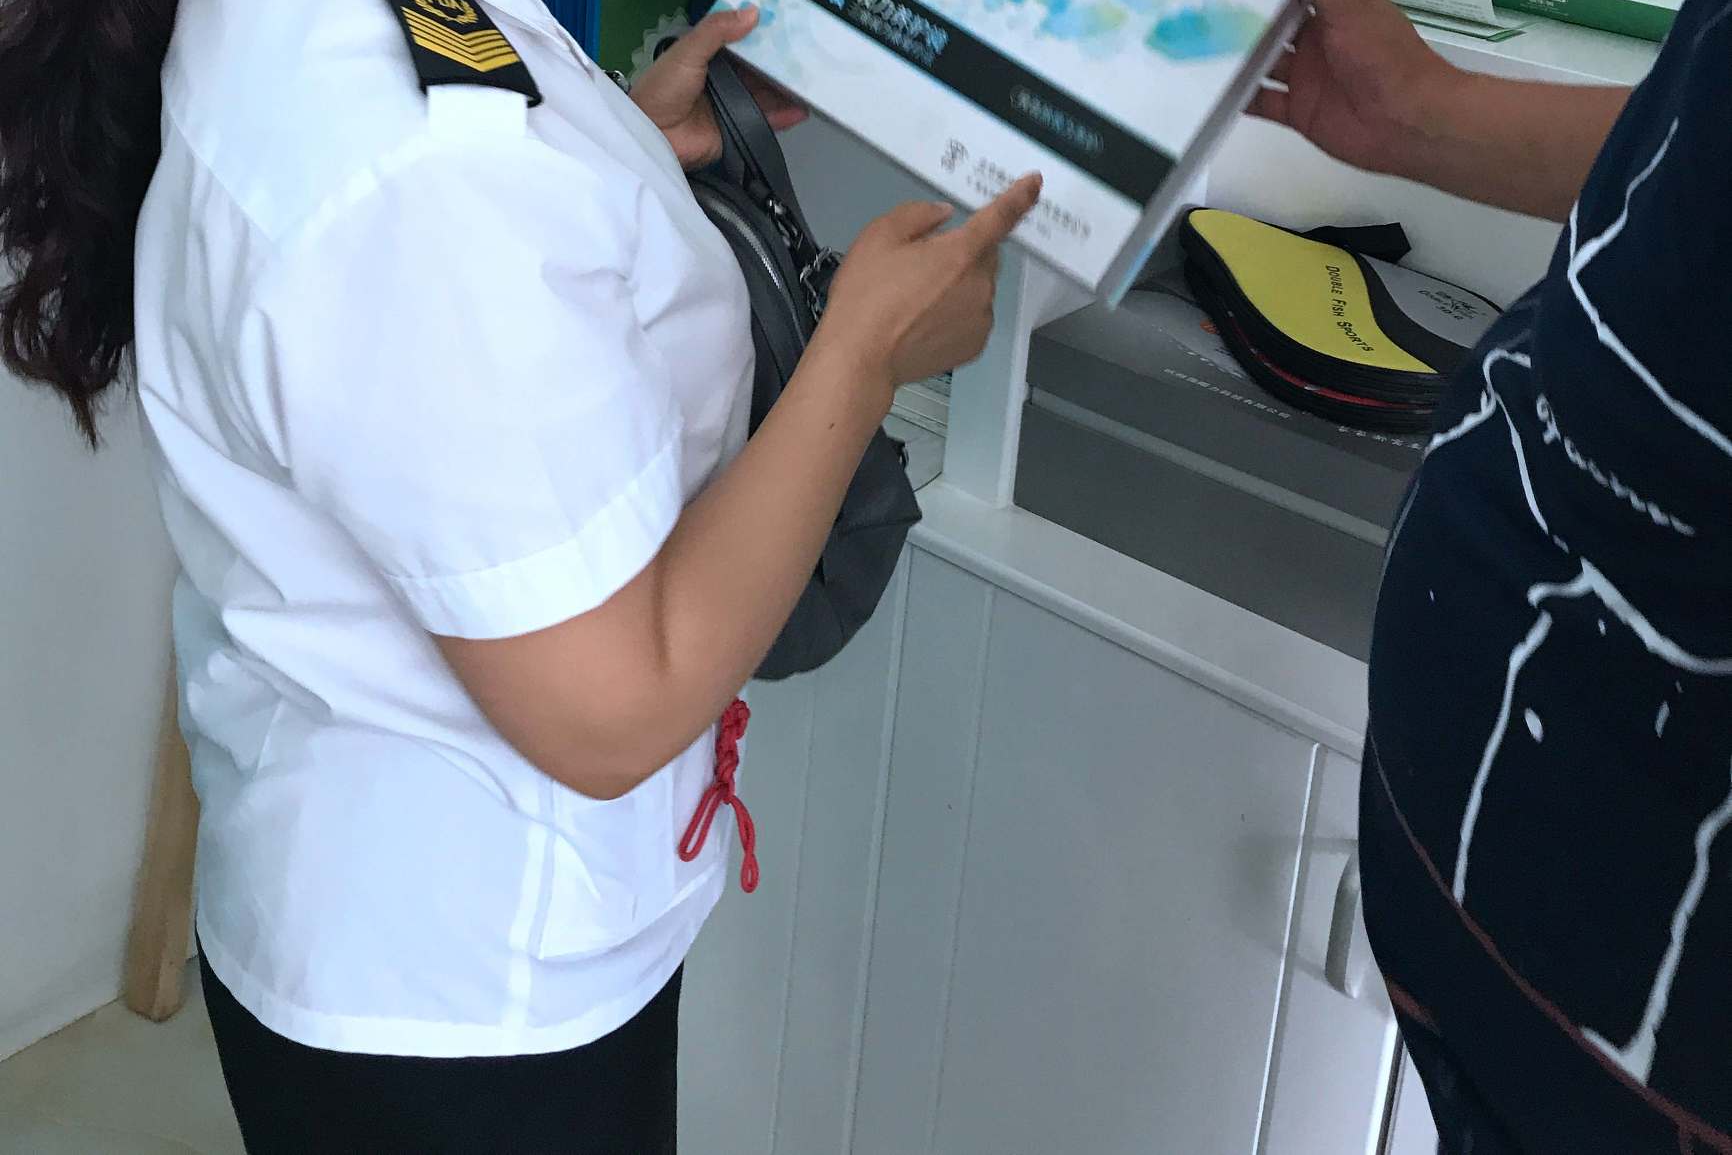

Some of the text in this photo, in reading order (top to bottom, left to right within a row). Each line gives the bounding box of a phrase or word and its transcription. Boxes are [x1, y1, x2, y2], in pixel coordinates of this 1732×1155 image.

[1325, 265, 1375, 352] DOUBLE FISH SPORTS
